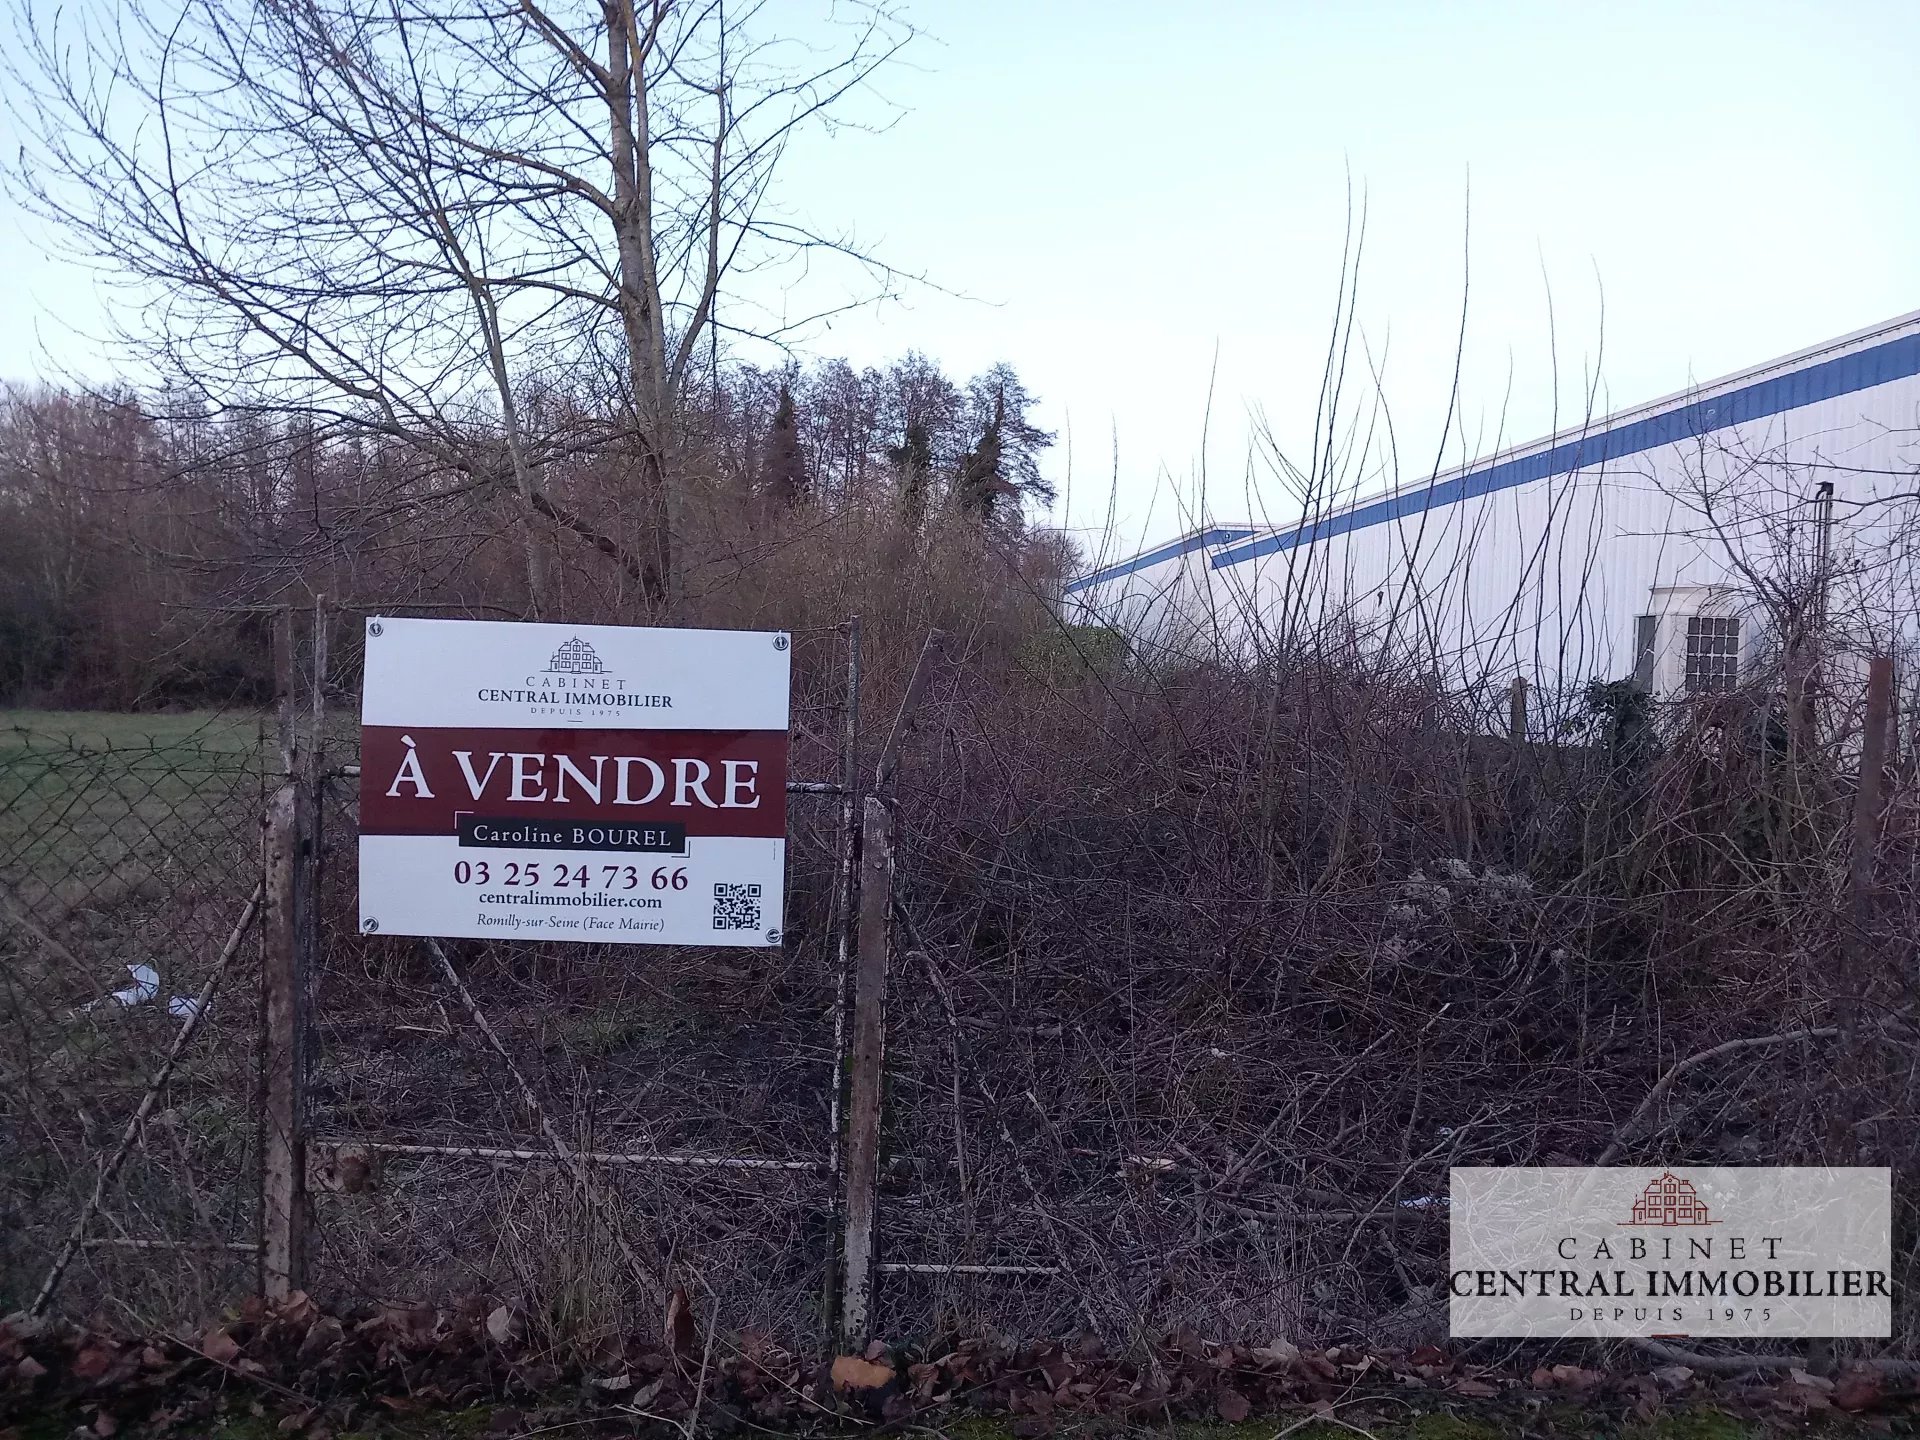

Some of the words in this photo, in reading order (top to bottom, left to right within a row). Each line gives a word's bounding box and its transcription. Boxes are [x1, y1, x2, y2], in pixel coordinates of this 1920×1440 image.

[526, 676, 626, 690] CABINET
[478, 688, 560, 705] CENTRAL
[565, 692, 673, 708] IMMOBILIER
[531, 707, 582, 716] DEPUIS
[386, 734, 435, 799] À
[452, 750, 760, 809] VENDRE
[473, 825, 563, 844] Caroline
[572, 829, 672, 846] BOUREL
[454, 860, 490, 885] 03
[504, 862, 539, 886] 25
[553, 864, 591, 888] 24
[602, 865, 638, 890] 73
[651, 866, 688, 890] 66
[479, 890, 662, 908] centralimmobilier.com
[477, 914, 580, 929] Romilly-sur-Seine
[583, 916, 615, 930] (Face
[618, 918, 665, 932] Mairie)
